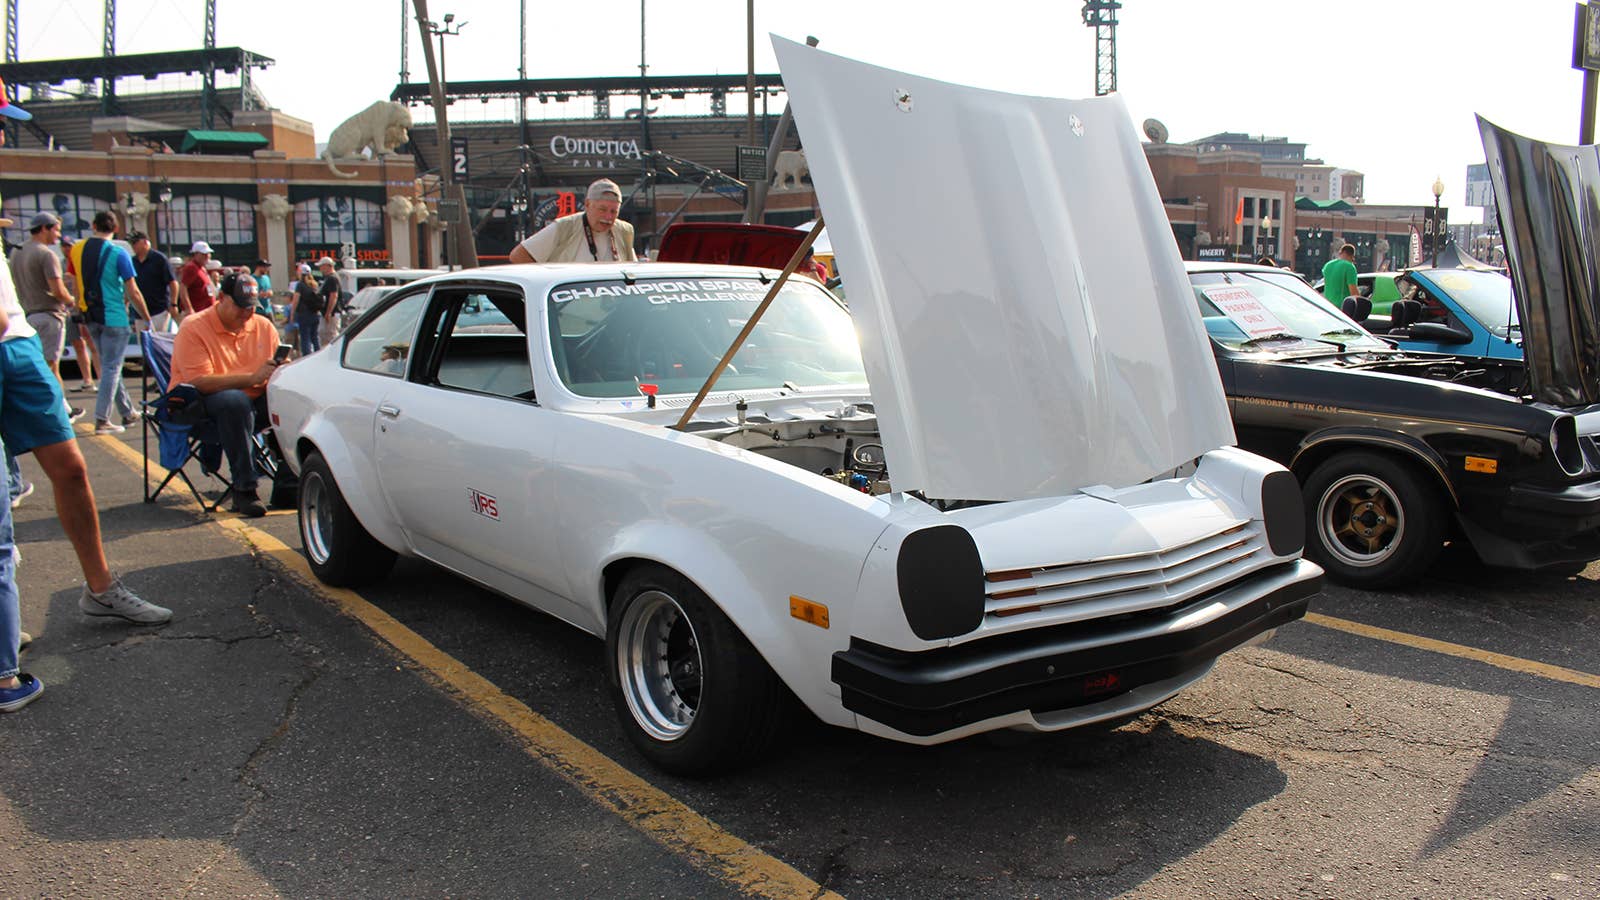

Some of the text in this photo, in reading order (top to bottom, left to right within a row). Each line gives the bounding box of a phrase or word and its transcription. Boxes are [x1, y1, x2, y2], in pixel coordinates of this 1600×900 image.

[454, 153, 466, 173] 2
[573, 159, 616, 169] PARK
[310, 249, 337, 261] THE
[357, 249, 390, 261] SHOP
[1199, 248, 1226, 257] HAGERTY
[551, 281, 698, 303] CHAMPION
[1224, 302, 1262, 312] PARKING
[1242, 314, 1265, 323] ONLY
[1243, 396, 1338, 414] COSWORTH TWIN CAM
